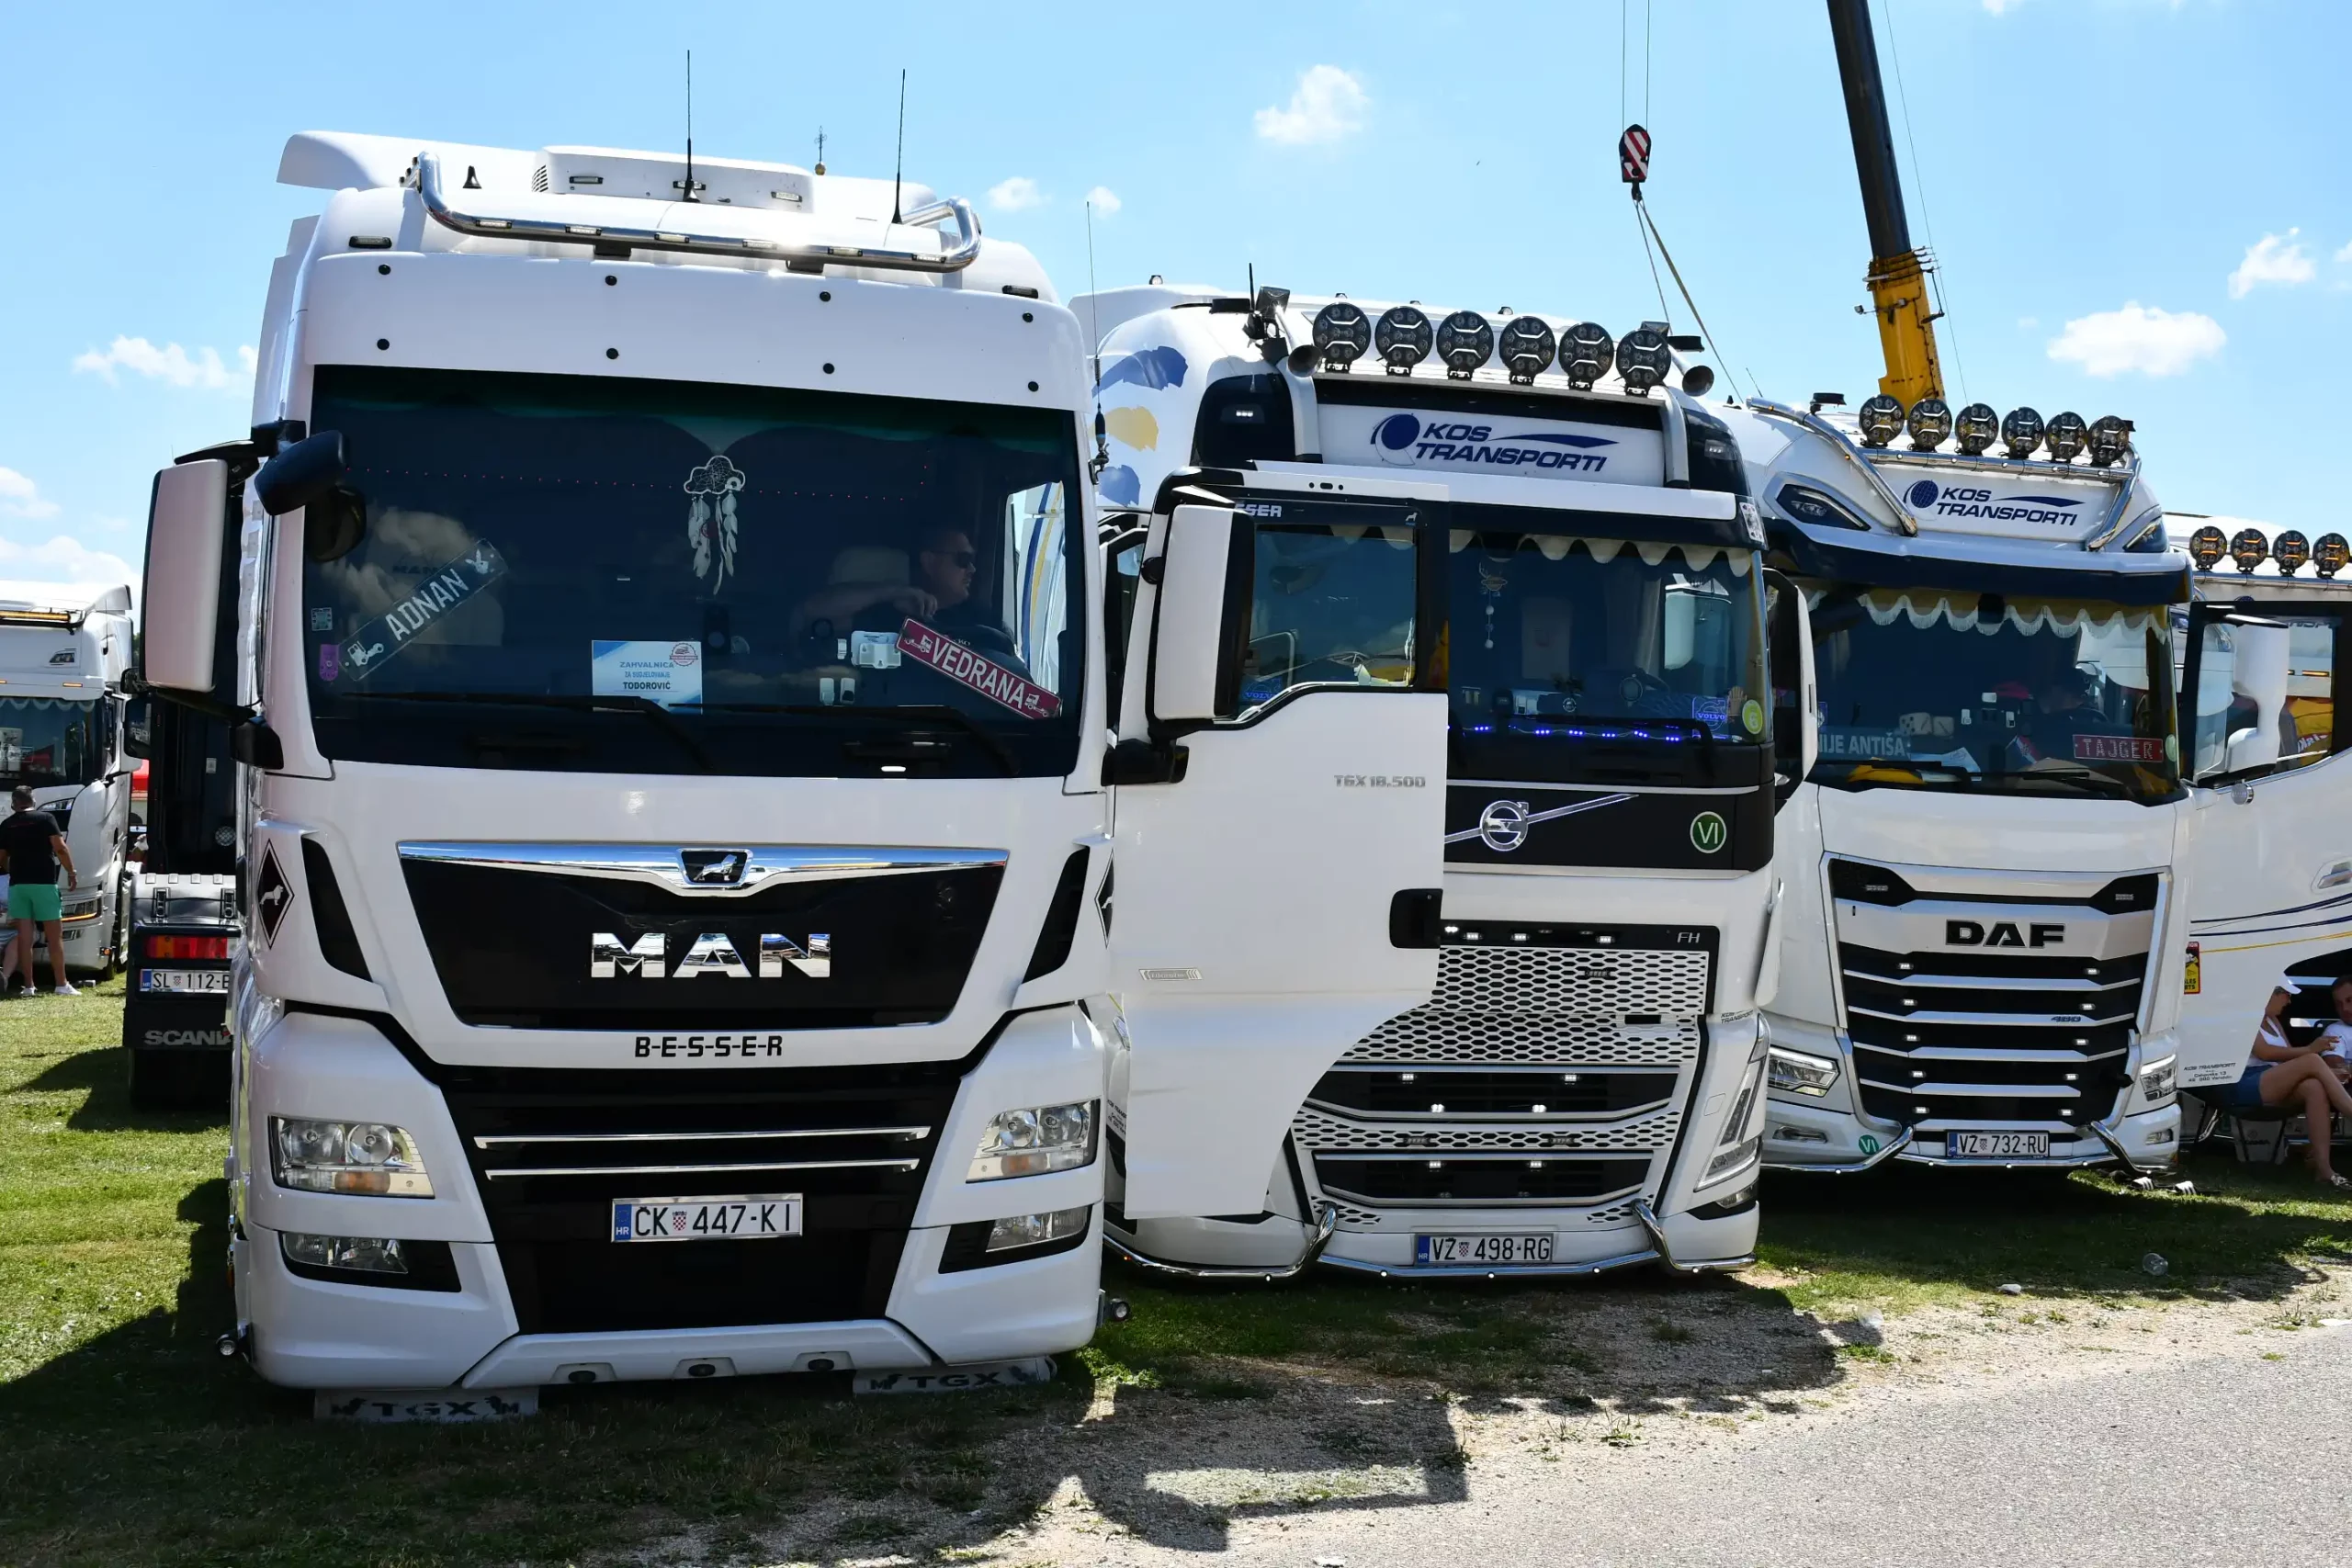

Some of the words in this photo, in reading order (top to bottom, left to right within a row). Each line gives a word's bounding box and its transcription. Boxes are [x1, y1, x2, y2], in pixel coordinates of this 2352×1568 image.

[1422, 423, 1492, 442] KOS
[1415, 442, 1607, 472] TRANSPORTI
[1941, 487, 1992, 502] KOS
[1937, 502, 2077, 526] TRANSPORTI
[385, 569, 469, 641] ADNAN
[933, 637, 1028, 710] VEDRANA
[623, 681, 671, 690] TODOROVIĆ
[1849, 732, 1906, 757] ANTIŠA
[1333, 774, 1367, 787] TGX
[1369, 775, 1426, 788] 18.500
[1697, 821, 1719, 845] VI
[1677, 931, 1701, 944] FH
[1945, 919, 2065, 949] DAF
[591, 932, 831, 978] MAN
[153, 974, 171, 988] SL
[1860, 1138, 1877, 1153] VI
[1959, 1134, 1979, 1154] VŽ
[1991, 1134, 2047, 1154] 732-RU
[635, 1206, 669, 1236] ČK
[692, 1203, 790, 1235] 447-KI
[616, 1226, 629, 1235] HR
[1432, 1237, 1457, 1260] VŽ
[1474, 1237, 1550, 1260] 498-RG
[908, 1371, 1001, 1389] TGX
[371, 1401, 479, 1416] TGX
